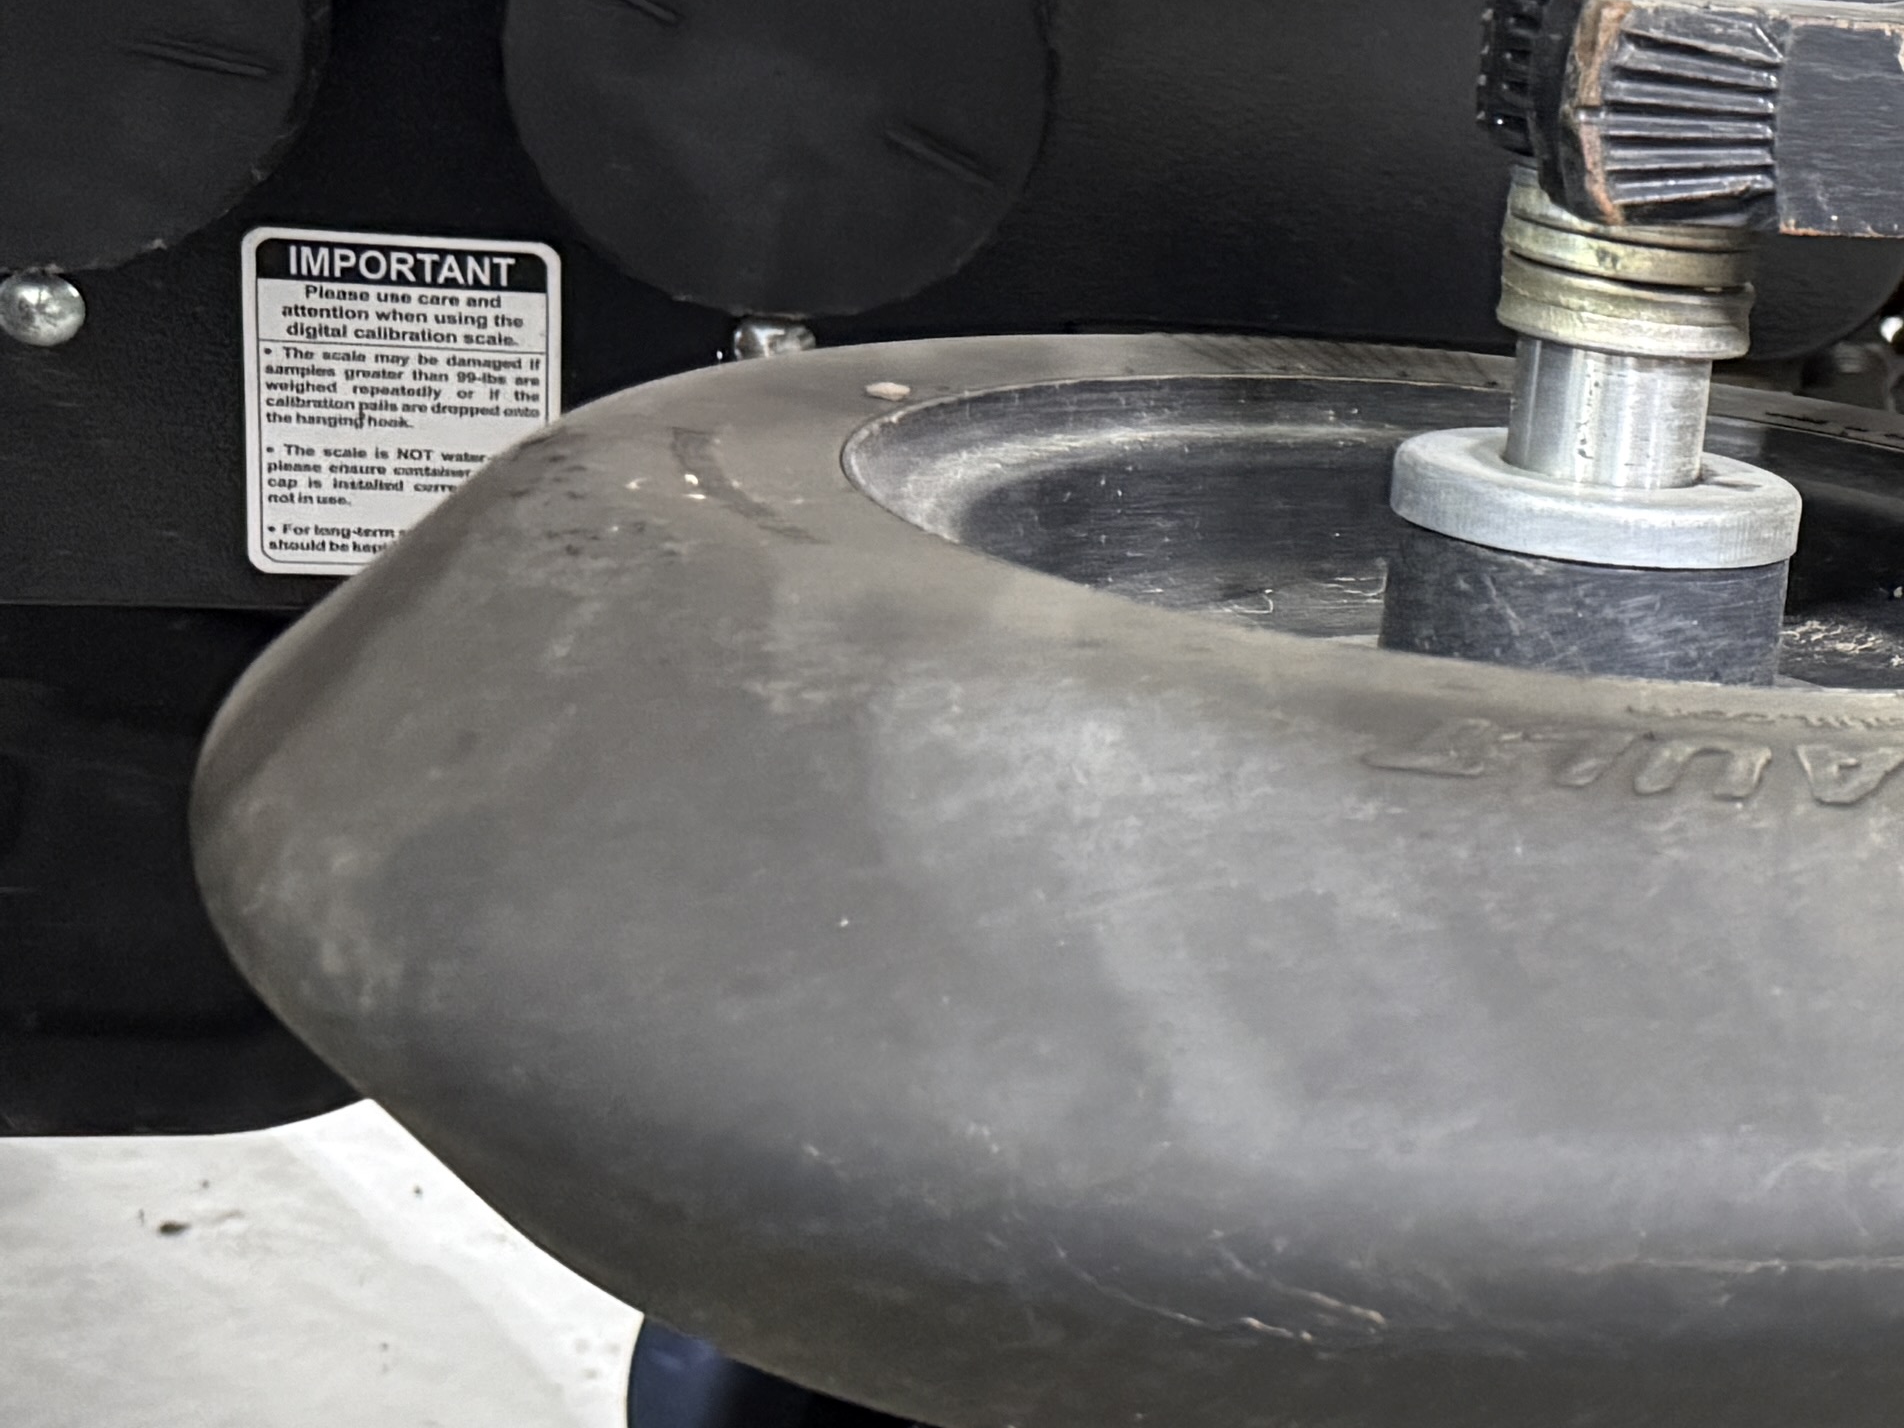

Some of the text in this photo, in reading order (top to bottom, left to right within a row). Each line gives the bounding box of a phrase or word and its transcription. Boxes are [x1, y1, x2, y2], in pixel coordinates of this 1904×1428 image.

[289, 244, 516, 288] IMPORTANT
[304, 283, 502, 309] Please use care and
[281, 303, 524, 330] attention when using the
[285, 321, 348, 341] digital
[353, 325, 458, 345] calibration
[281, 345, 315, 361] The
[321, 349, 367, 363] scale
[374, 353, 411, 368] may
[417, 351, 439, 367] be
[446, 354, 523, 372] damaged
[264, 363, 337, 379] samples
[343, 367, 405, 382] greater
[411, 368, 450, 383] than
[515, 375, 541, 387] are
[264, 379, 338, 395] weighed
[352, 383, 442, 402] repeatedly
[456, 389, 475, 400] or
[513, 389, 541, 403] the
[265, 394, 356, 411] calibration
[401, 402, 429, 414] are
[430, 401, 501, 419] dropped
[265, 411, 293, 425] the
[295, 411, 364, 430] hanging
[283, 442, 317, 458] The
[322, 446, 368, 459] scale
[374, 445, 390, 460] is
[397, 446, 435, 462] NOT
[267, 459, 323, 475] please
[328, 462, 388, 476] ensure
[267, 476, 299, 492] cap
[268, 538, 327, 553] should
